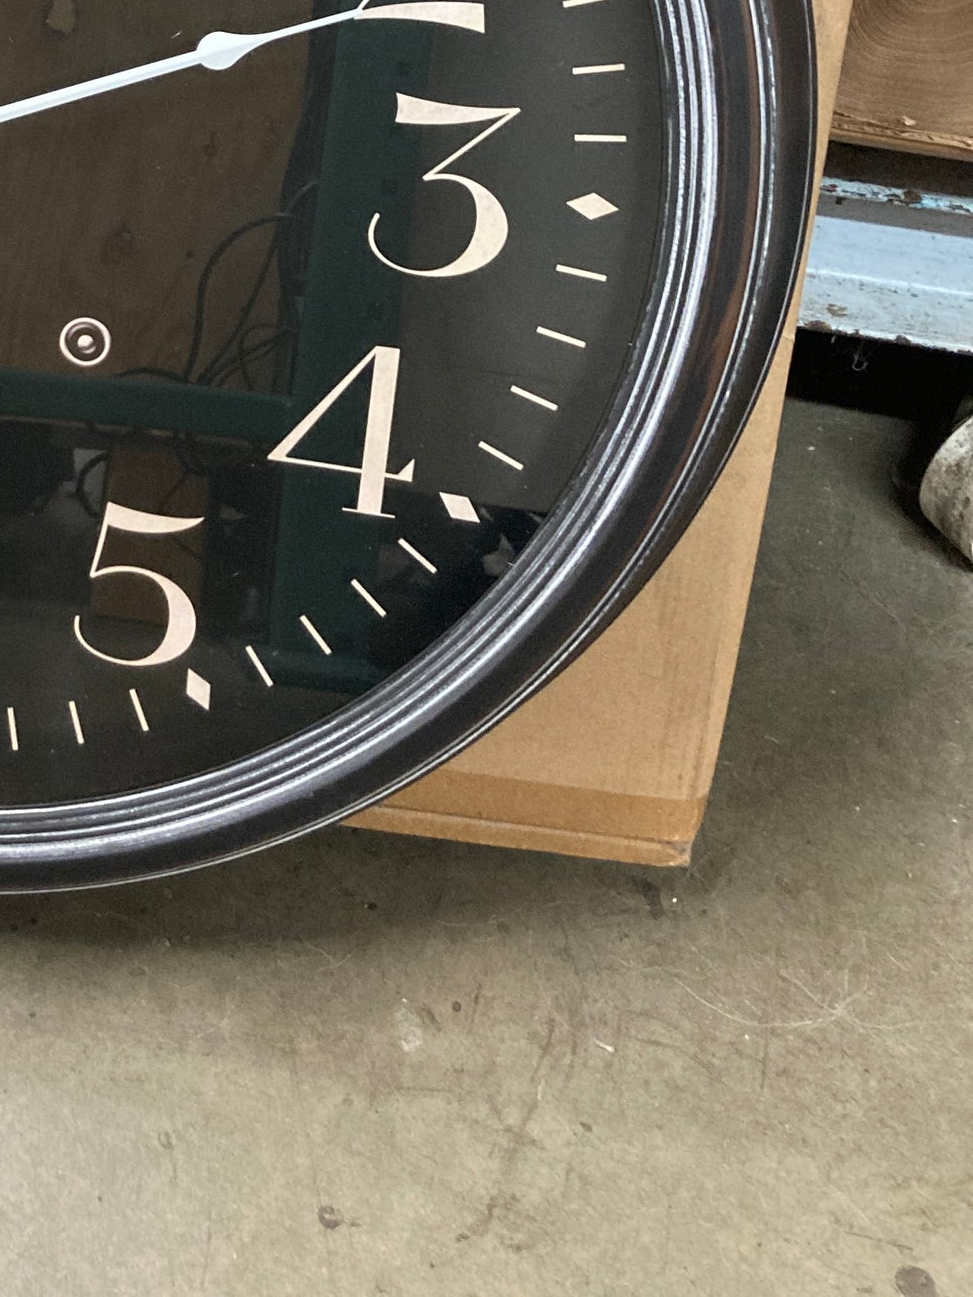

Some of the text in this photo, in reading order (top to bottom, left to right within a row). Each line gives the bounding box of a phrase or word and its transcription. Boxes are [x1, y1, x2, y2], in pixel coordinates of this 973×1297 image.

[367, 92, 522, 278] 3
[266, 345, 416, 519] 4
[73, 501, 205, 667] 5
